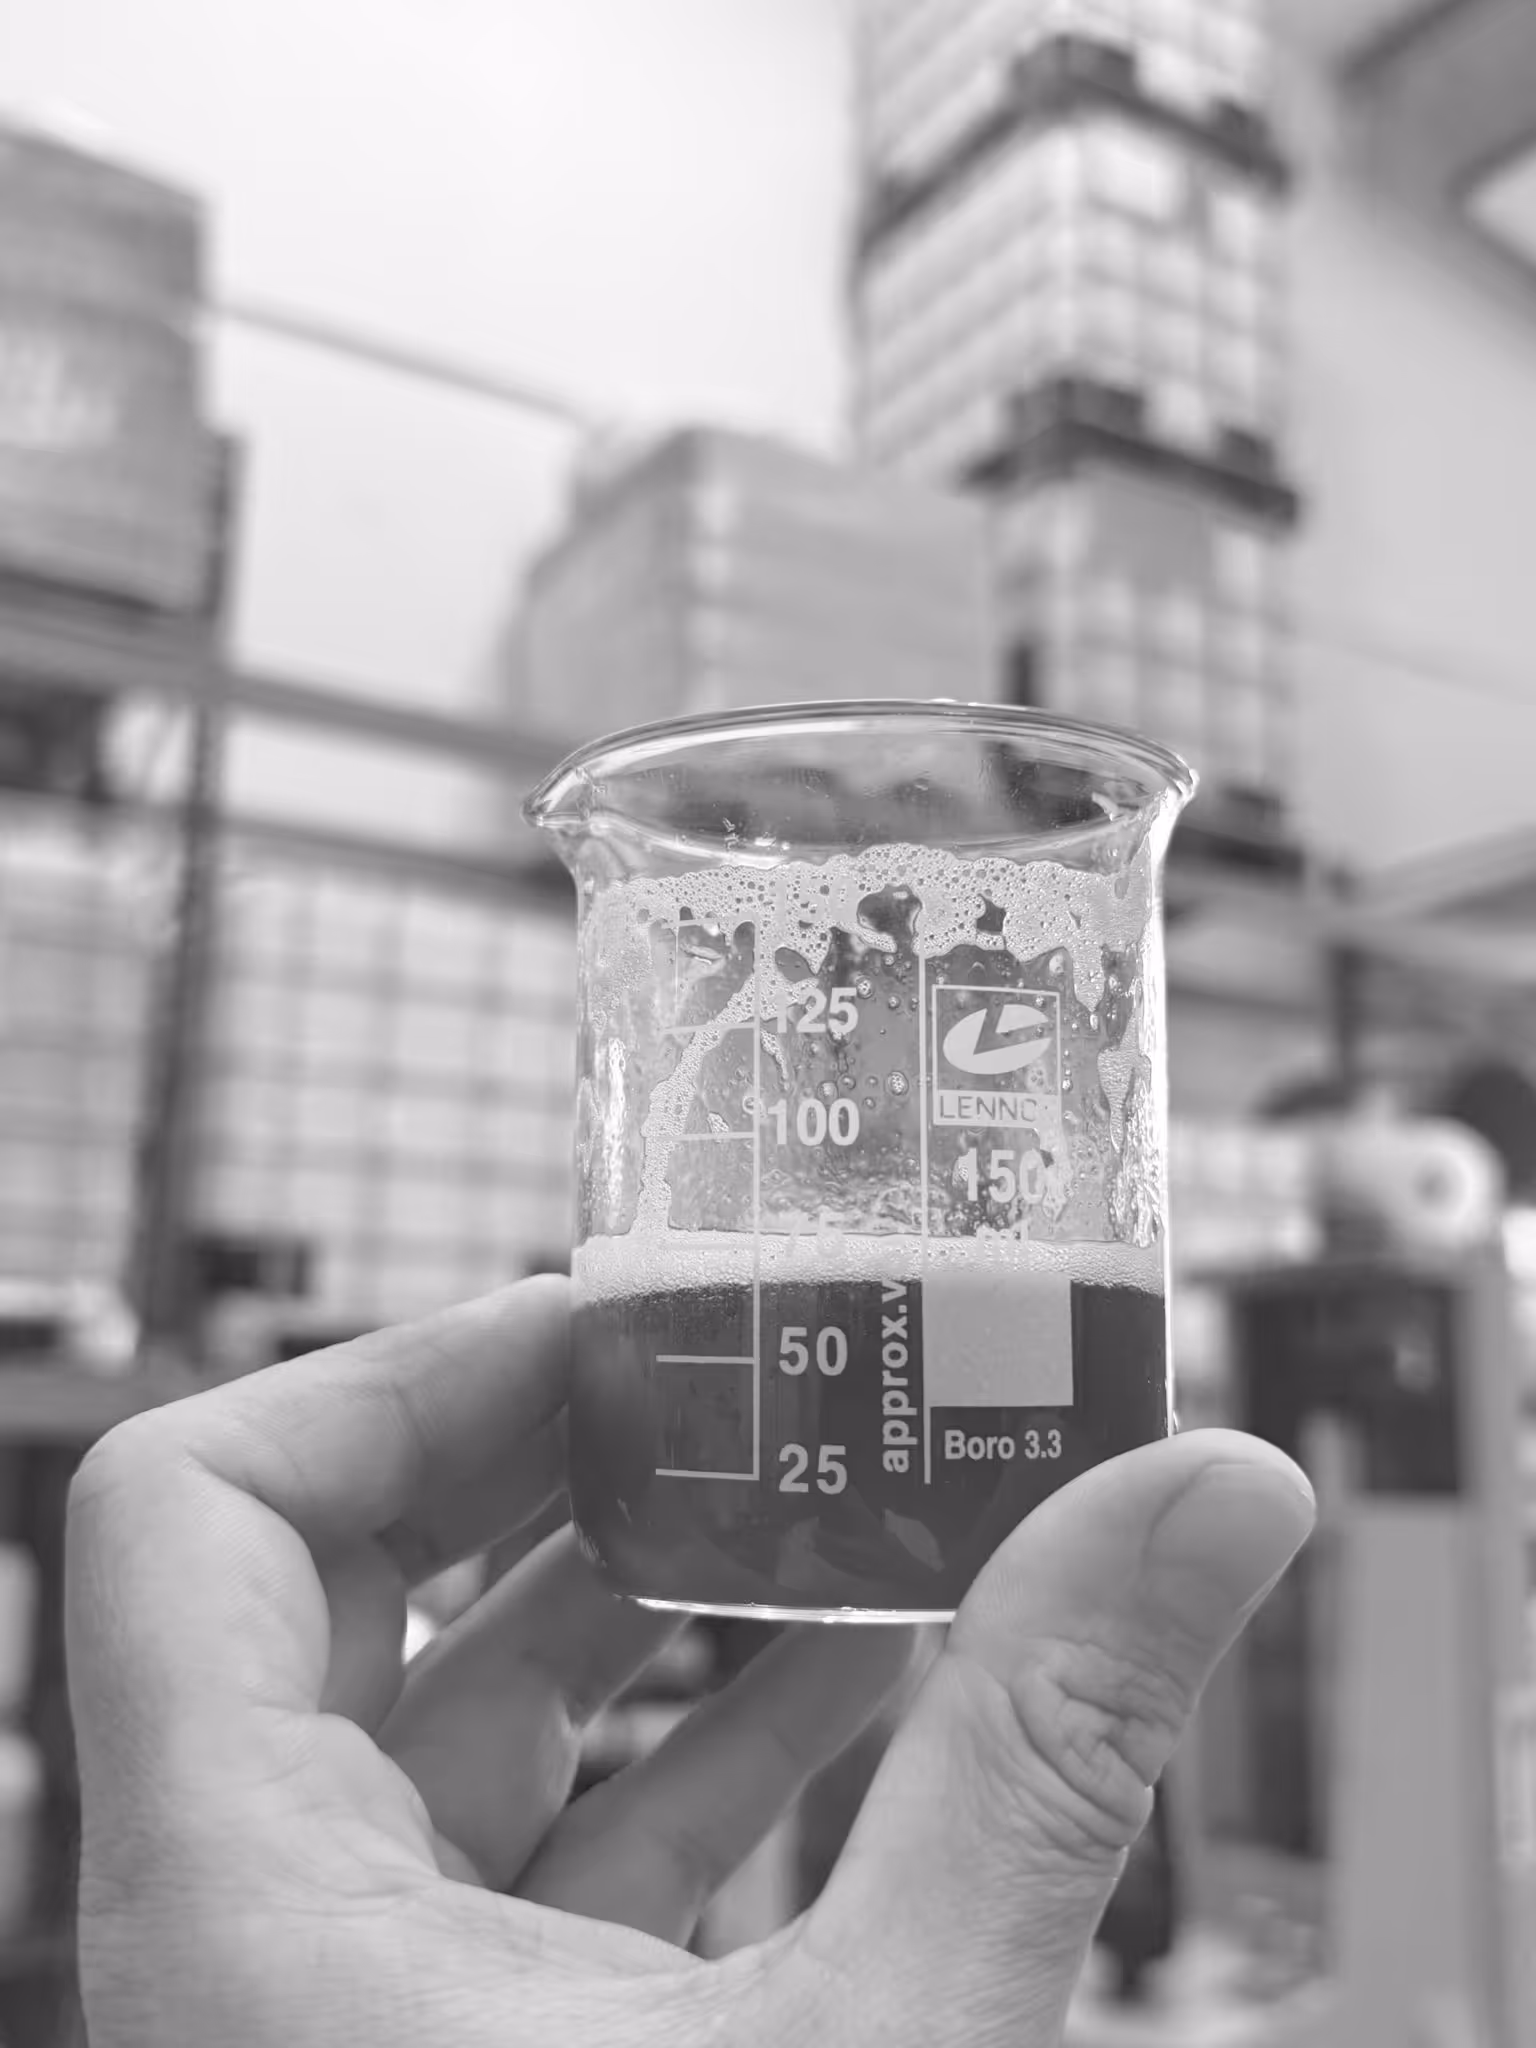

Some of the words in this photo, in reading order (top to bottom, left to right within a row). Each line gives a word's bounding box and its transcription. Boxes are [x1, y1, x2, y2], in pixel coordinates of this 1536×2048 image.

[775, 986, 859, 1034] 125
[767, 1098, 860, 1146] 100
[939, 1095, 1044, 1123] LENNO
[953, 1147, 1049, 1204] 150
[778, 1326, 848, 1376] 50
[881, 1279, 918, 1473] approx.v
[778, 1443, 848, 1495] 25
[944, 1429, 1015, 1460] Boro
[1024, 1429, 1062, 1459] 3.3
